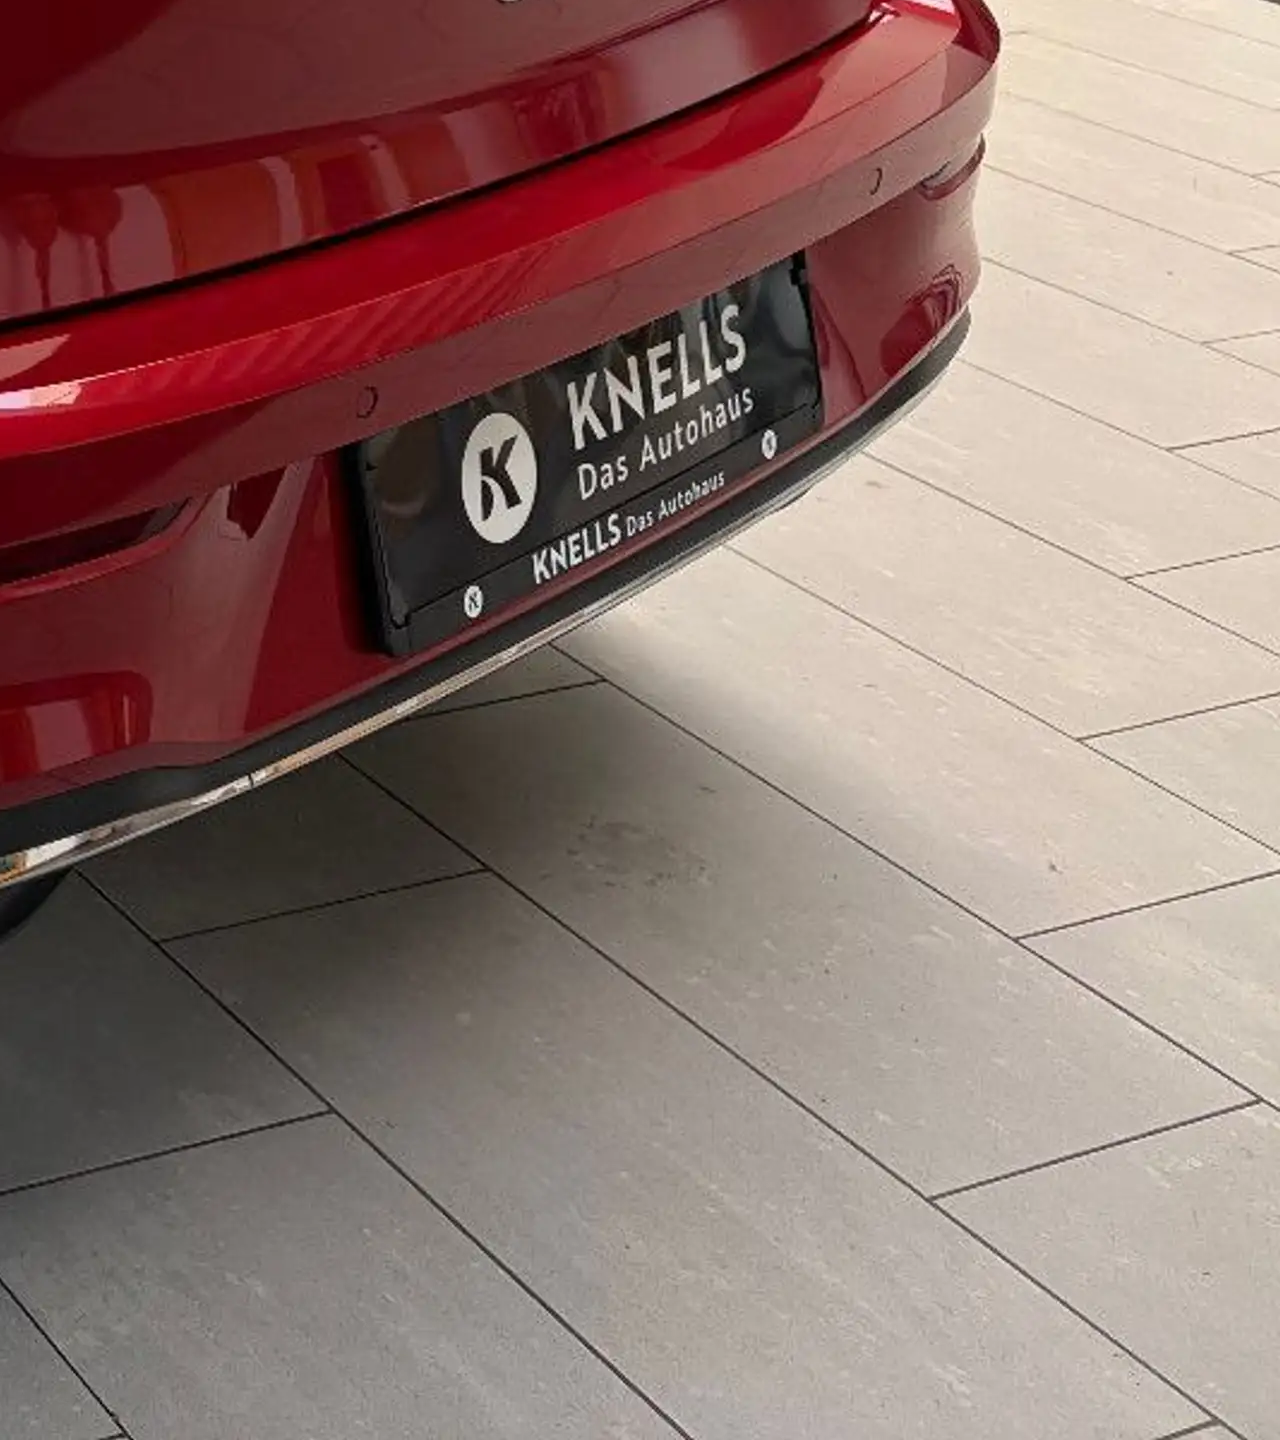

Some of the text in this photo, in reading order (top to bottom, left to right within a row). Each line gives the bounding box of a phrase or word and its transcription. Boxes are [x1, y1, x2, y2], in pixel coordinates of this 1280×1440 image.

[567, 304, 746, 450] KNELLS
[578, 455, 628, 500] Das
[639, 387, 754, 471] Autohaus
[531, 471, 725, 584] KNELLS Das Autohaus
